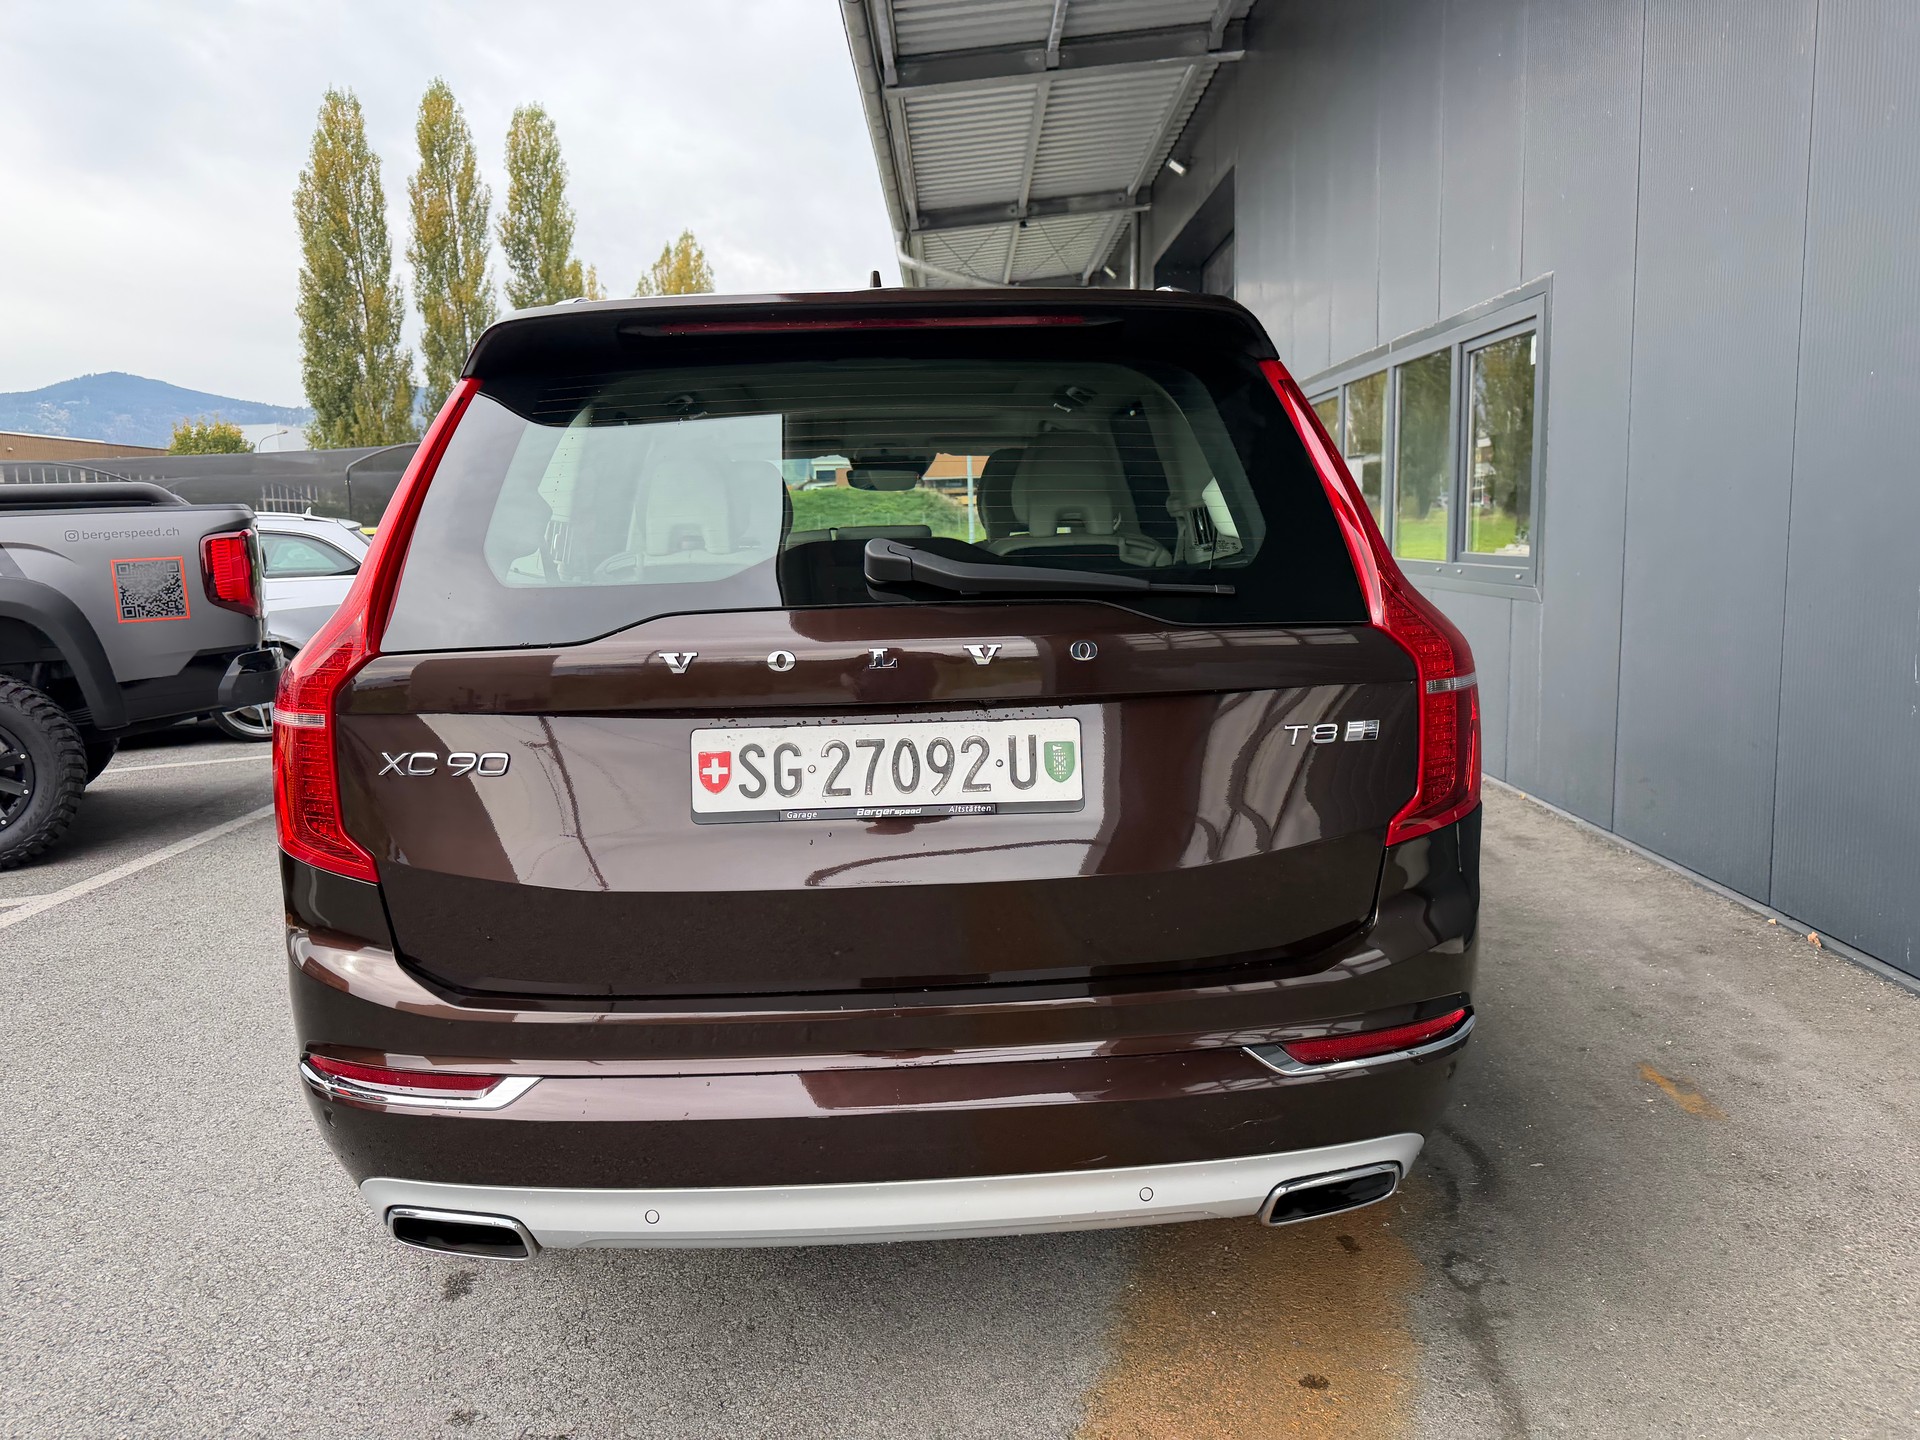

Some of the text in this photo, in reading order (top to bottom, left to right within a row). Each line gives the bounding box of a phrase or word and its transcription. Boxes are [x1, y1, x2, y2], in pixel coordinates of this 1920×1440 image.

[82, 527, 180, 541] bergerspeed.ch
[658, 639, 1099, 675] VOLVO
[1283, 723, 1339, 746] T8
[738, 734, 1038, 799] SG 27092 U
[786, 804, 993, 820] Garage Bergerspeed Altstätten
